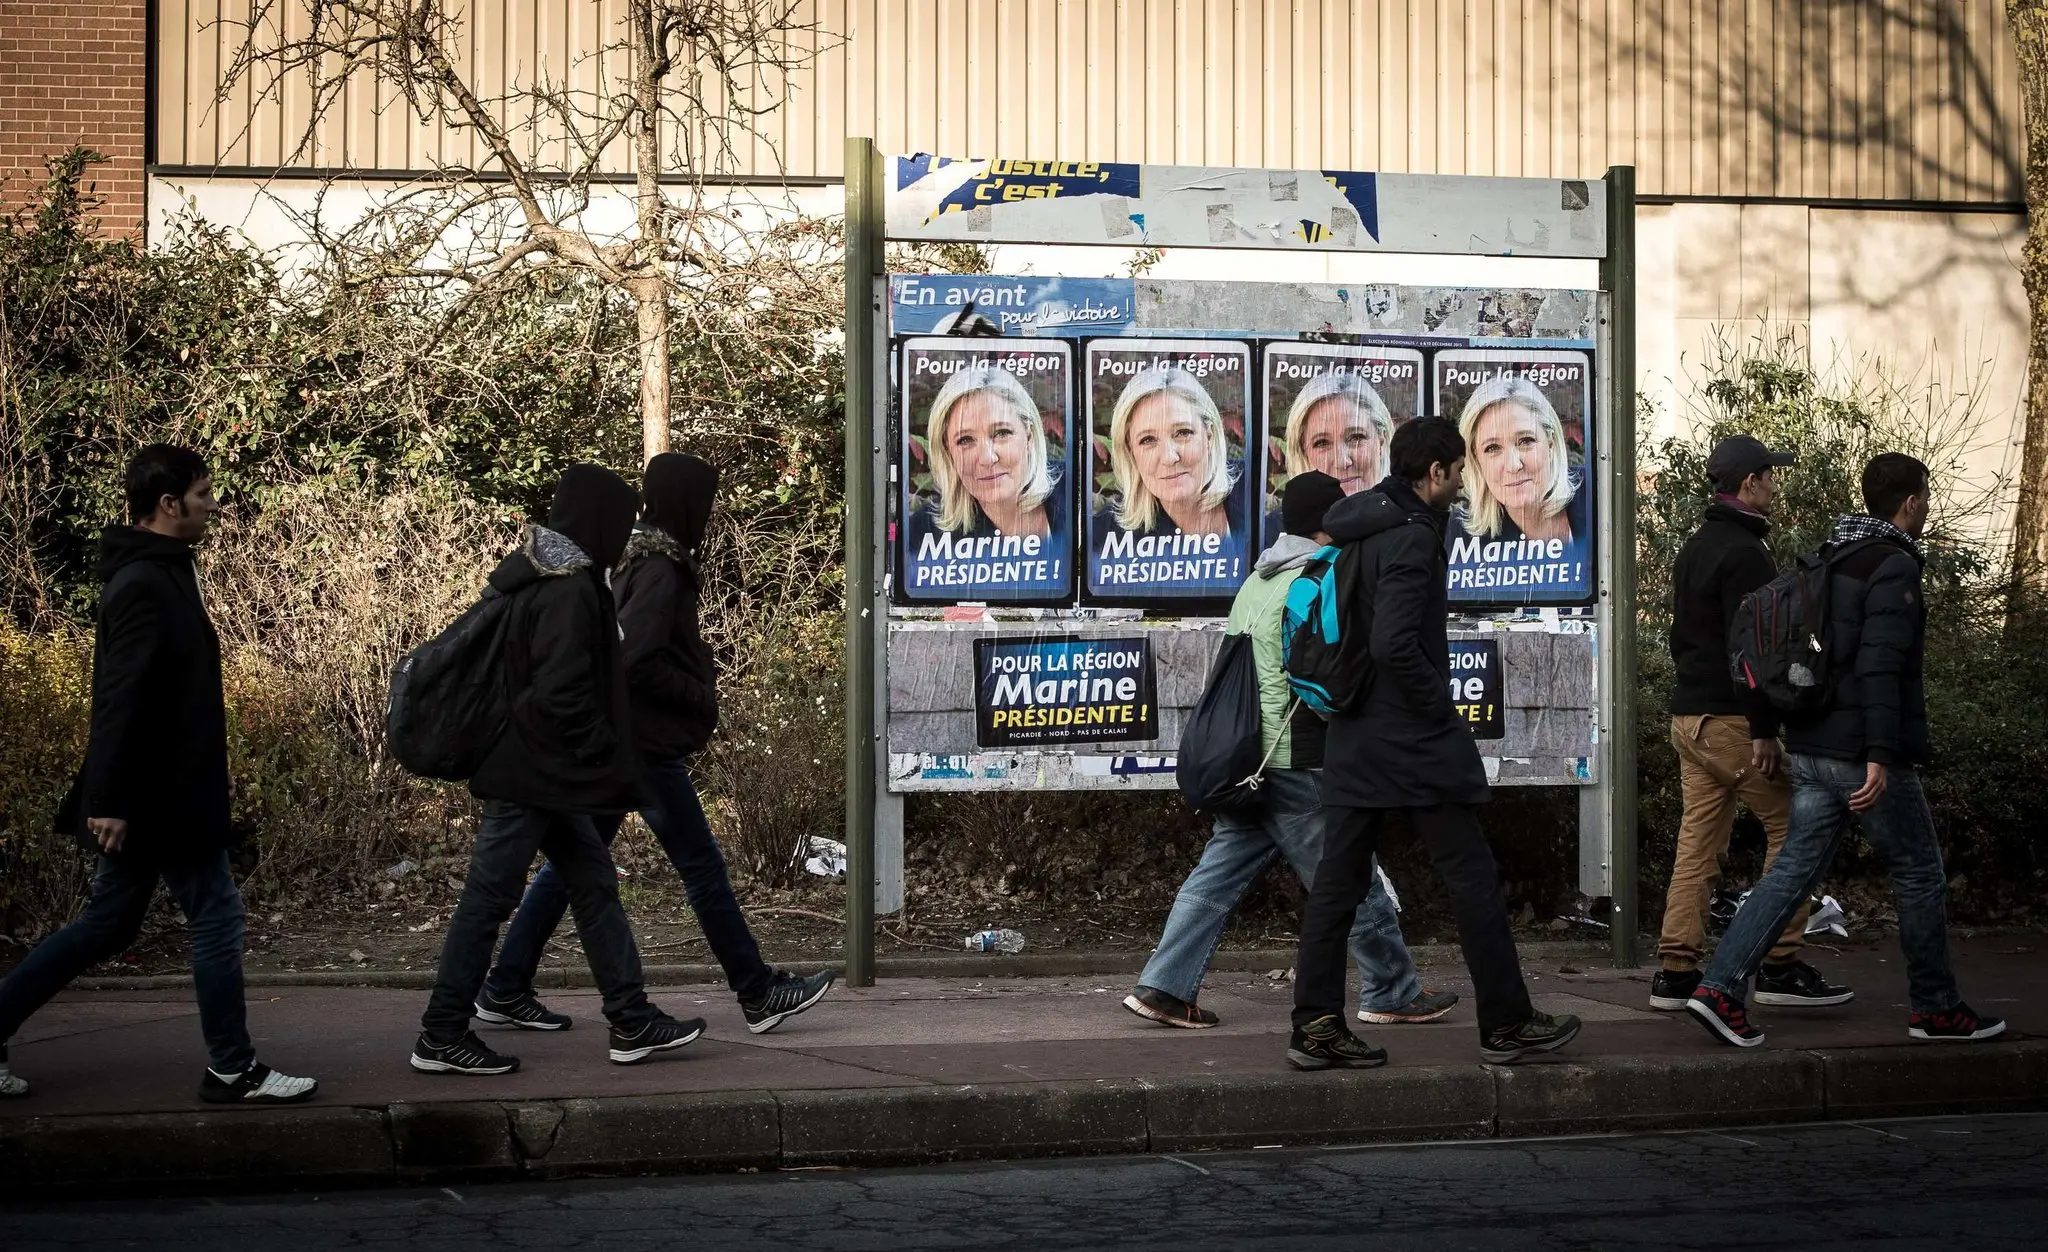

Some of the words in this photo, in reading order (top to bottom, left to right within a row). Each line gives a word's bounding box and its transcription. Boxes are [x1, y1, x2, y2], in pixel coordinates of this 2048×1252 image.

[975, 178, 1063, 200] c'est
[900, 279, 936, 305] En
[945, 284, 1027, 307] avant
[1000, 311, 1037, 333] pour
[1065, 297, 1121, 322] victoire
[1125, 298, 1130, 319] !
[916, 357, 965, 375] Pour
[971, 355, 990, 372] la
[996, 353, 1060, 377] région
[1098, 358, 1146, 376] Pour
[1152, 356, 1170, 373] la
[1177, 353, 1239, 377] région
[1275, 361, 1322, 378] Pour
[1328, 361, 1346, 378] la
[1353, 359, 1413, 383] région
[1445, 368, 1491, 386] Pour
[1496, 366, 1514, 383] la
[1520, 363, 1579, 387] région
[917, 529, 1041, 562] Marine
[1100, 528, 1221, 560] Marine
[1448, 533, 1563, 565] Marine
[916, 560, 1048, 587] PRÉSIDENTE
[1053, 559, 1060, 579] !
[1099, 558, 1227, 585] PRÉSIDENTE
[1232, 557, 1239, 578] !
[1448, 562, 1570, 590] PRÉSIDENTE
[1575, 562, 1582, 582] !
[991, 655, 1042, 674] POUR
[1047, 654, 1068, 672] LA
[1073, 649, 1140, 671] RÉGION
[1448, 652, 1487, 670] GION
[991, 671, 1137, 706] Marine
[992, 704, 1134, 728] PRÉSIDENTE
[1140, 704, 1148, 722] !
[1009, 731, 1041, 739] PICARDIE
[1103, 727, 1128, 735] CALAIS
